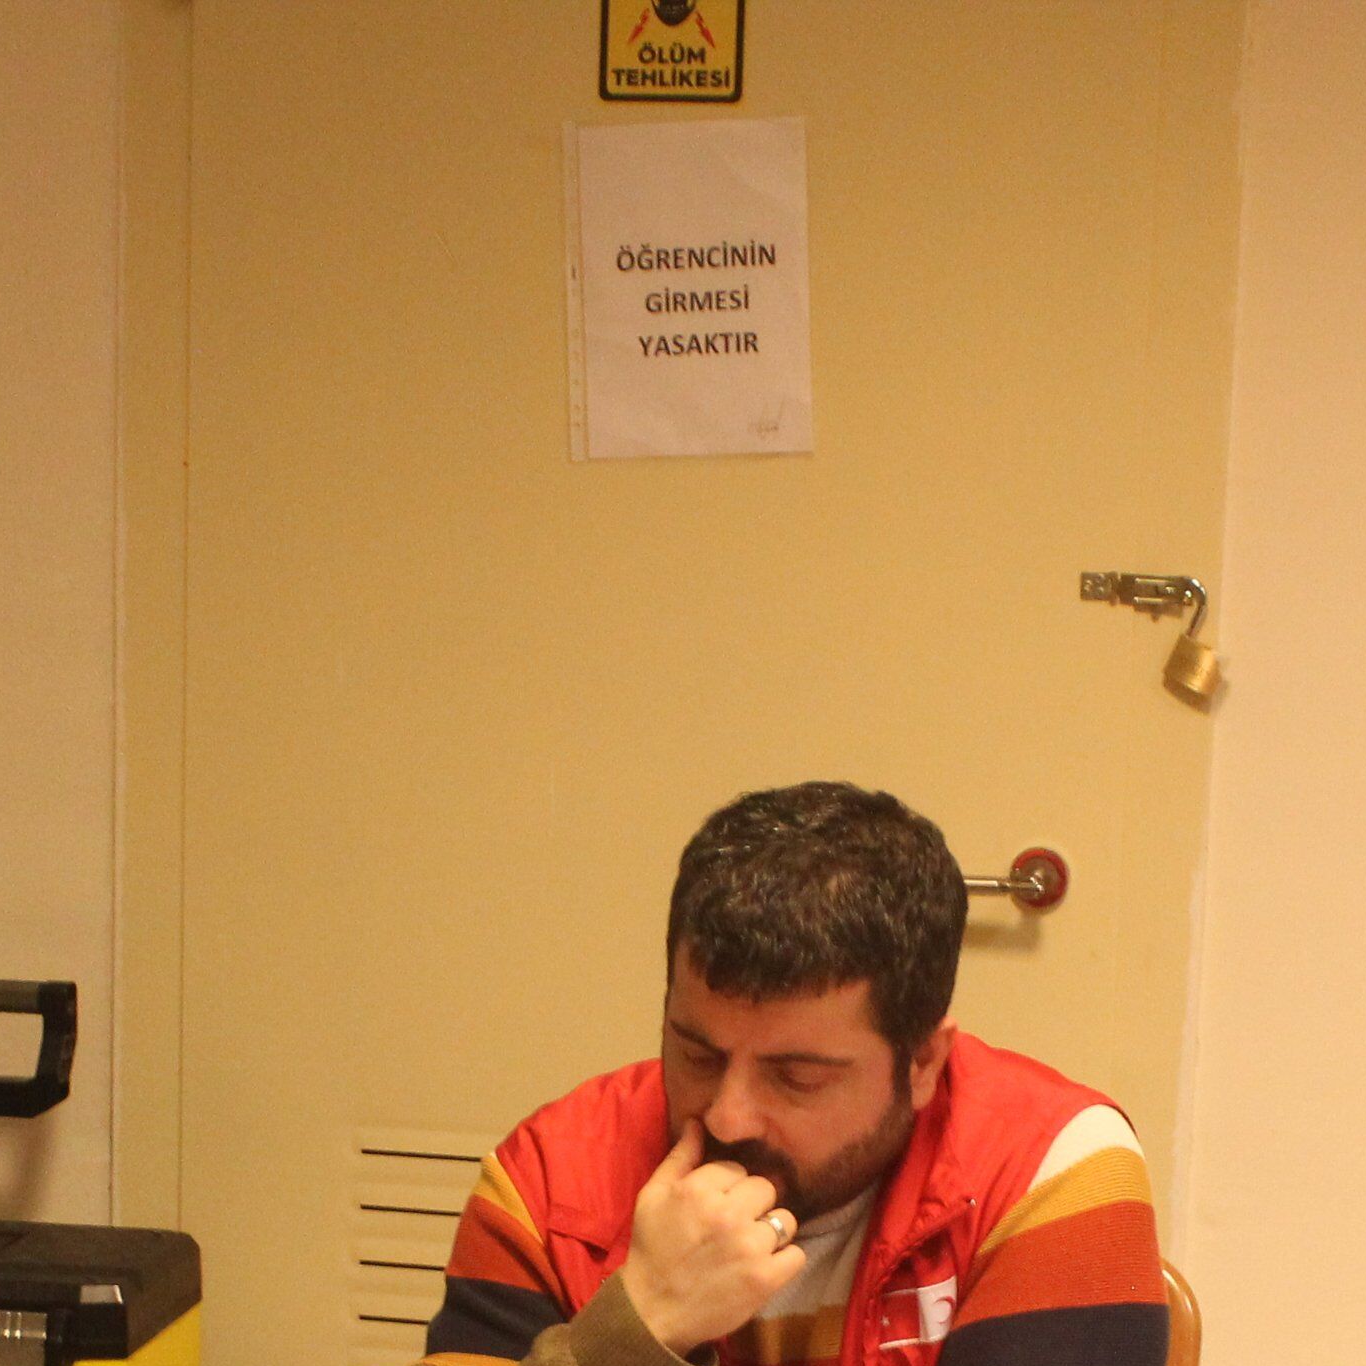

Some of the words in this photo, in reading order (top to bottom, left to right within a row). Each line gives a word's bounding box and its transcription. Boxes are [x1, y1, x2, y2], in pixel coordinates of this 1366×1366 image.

[638, 42, 706, 65] ÖLÜM
[611, 66, 731, 88] TEHLİKESİ
[616, 239, 776, 271] ÖĞRENCİNİN
[645, 283, 750, 314] GİRMESİ
[639, 331, 759, 357] YASAKTIR
